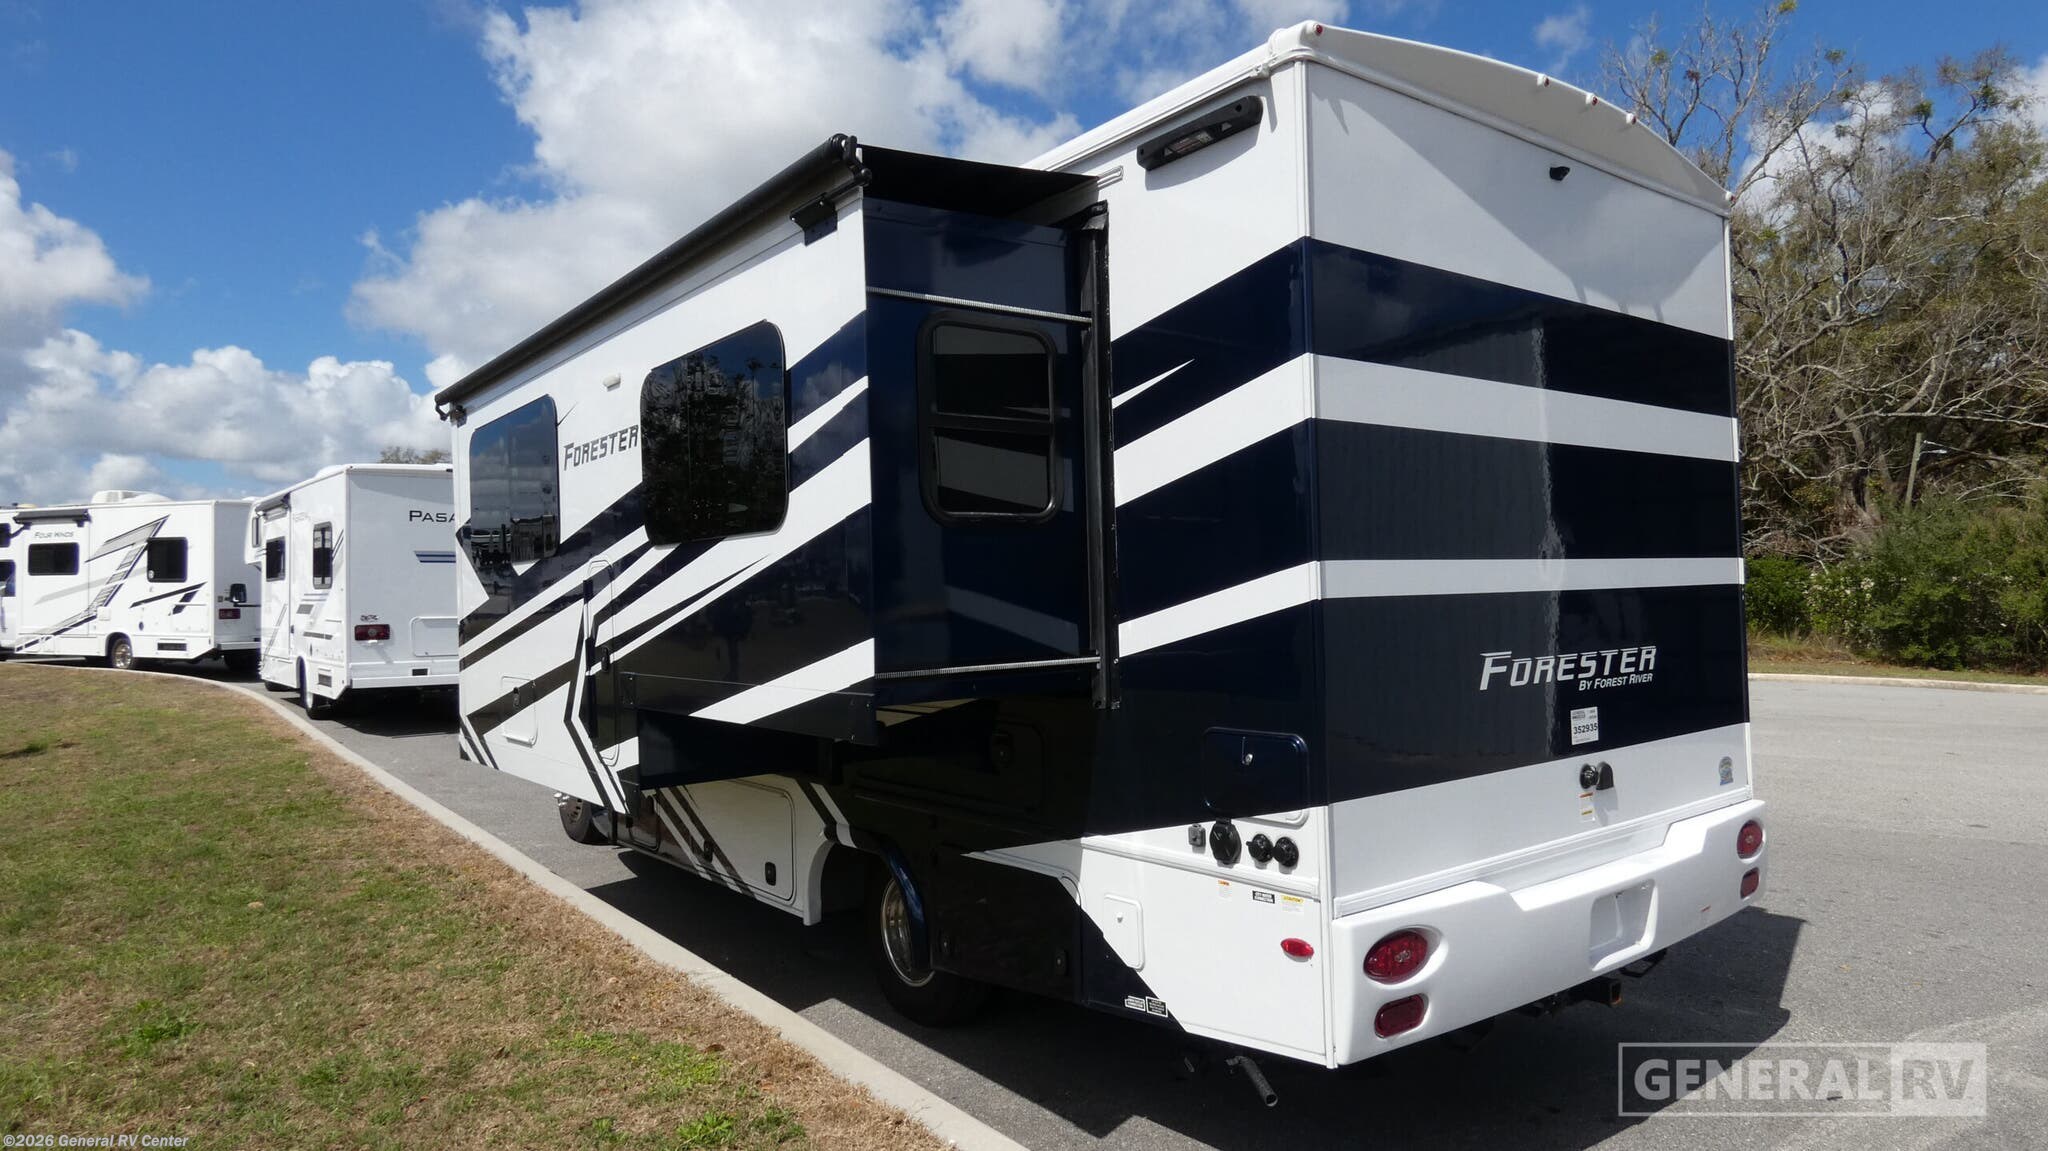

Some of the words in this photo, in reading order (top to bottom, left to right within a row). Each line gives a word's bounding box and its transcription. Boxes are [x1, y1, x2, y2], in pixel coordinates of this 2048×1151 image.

[563, 424, 639, 471] FORESTER
[1479, 645, 1657, 691] FORESTER
[1578, 680, 1592, 691] BY
[1593, 676, 1628, 689] FOREST
[1628, 673, 1653, 685] RIVER
[1573, 722, 1598, 735] 352935
